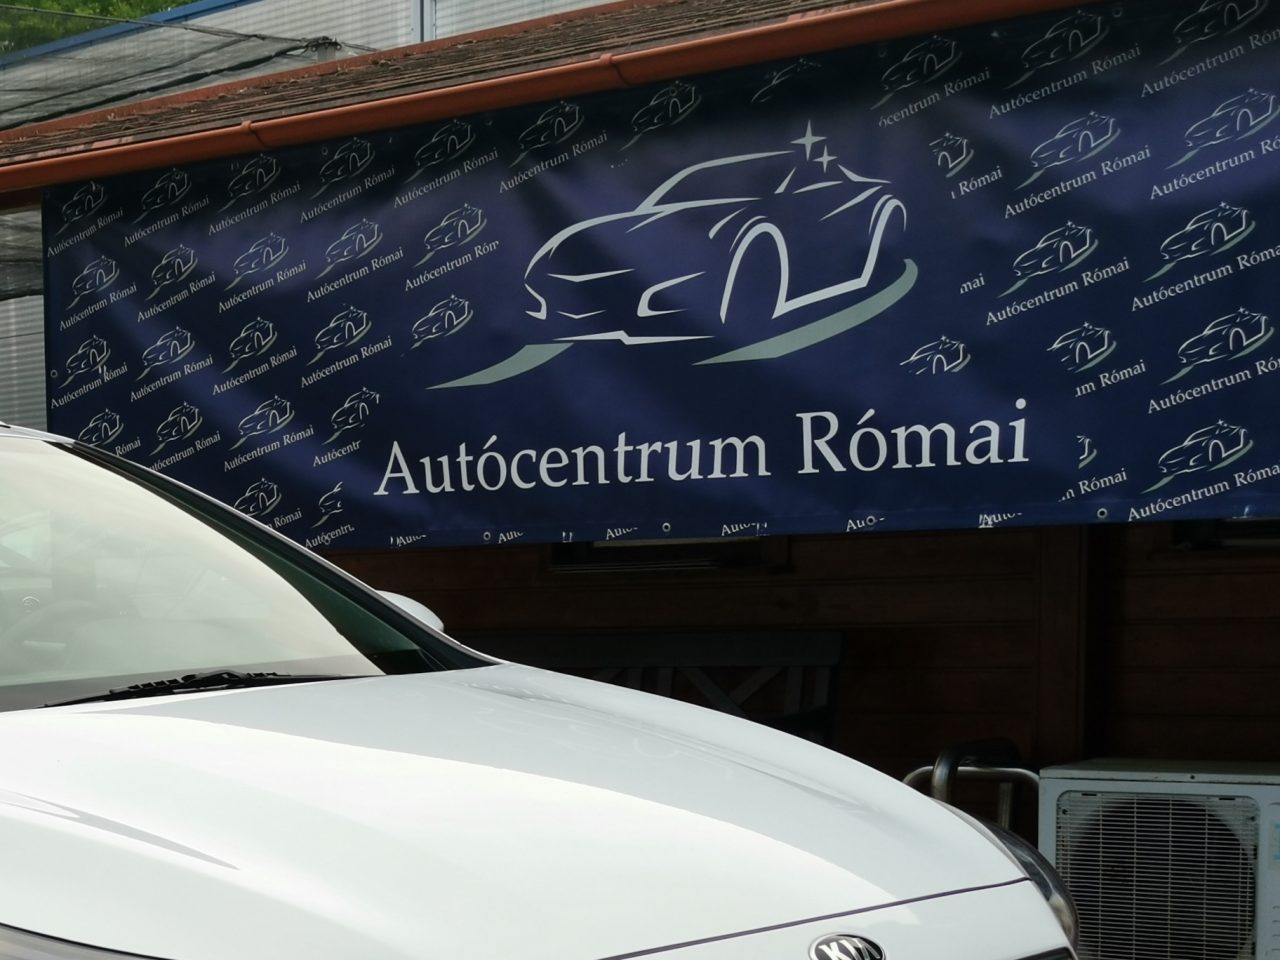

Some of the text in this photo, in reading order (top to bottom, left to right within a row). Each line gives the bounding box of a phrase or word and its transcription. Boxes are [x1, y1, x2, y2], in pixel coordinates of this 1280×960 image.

[944, 67, 990, 97] Római
[989, 43, 1141, 119] Autócentrum Római
[1141, 45, 1244, 98] Autócentrum
[393, 147, 499, 208] Autócentrum Római
[499, 130, 608, 194] Autócentrum Római
[959, 165, 1003, 196] Római
[1004, 145, 1151, 219] Autócentrum Római
[1150, 149, 1255, 200] Autócentrum
[208, 182, 301, 236] Autócentrum Római
[300, 167, 395, 224] Autócentrum Római
[47, 209, 124, 258] Autócentrum Római
[124, 196, 210, 247] Autócentrum Római
[137, 272, 216, 322] Autócentrum Római
[218, 260, 307, 313] Autócentrum Római
[307, 246, 404, 303] Autócentrum Római
[405, 253, 472, 291] Autócentrum
[985, 256, 1130, 326] Autócentrum Római
[1131, 264, 1233, 311] Autócentrum
[59, 283, 137, 331] Autócentrum Római
[130, 354, 213, 402] Autócentrum Római
[212, 346, 298, 396] Autócentrum Római
[300, 336, 392, 388] Autócentrum Római
[1100, 360, 1146, 387] Római
[51, 379, 102, 409] Autócentrum
[1148, 370, 1251, 414] Autócentrum
[148, 431, 221, 472] utócentrum Római
[223, 425, 314, 472] Autócentrum Római
[373, 398, 1030, 496] Autócentrum Római
[1078, 468, 1127, 494] Római
[1127, 480, 1230, 522] Autócentrum
[274, 507, 302, 529] Római
